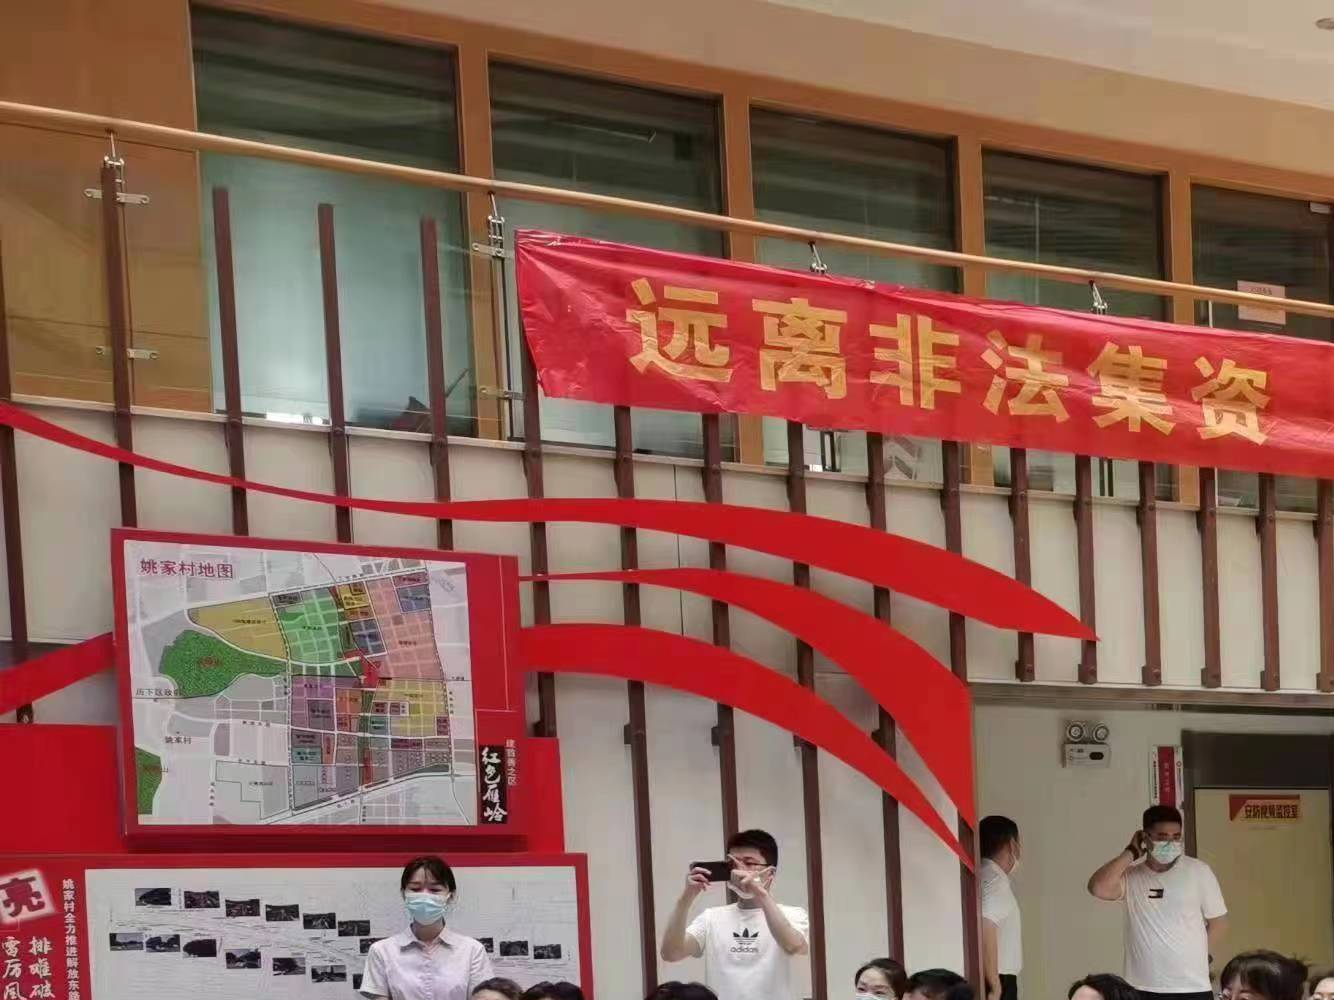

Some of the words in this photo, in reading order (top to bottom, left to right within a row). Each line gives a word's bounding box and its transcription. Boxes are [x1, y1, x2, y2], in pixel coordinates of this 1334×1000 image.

[626, 277, 1270, 445] 远离非法集资
[140, 558, 233, 579] 姚家村地图
